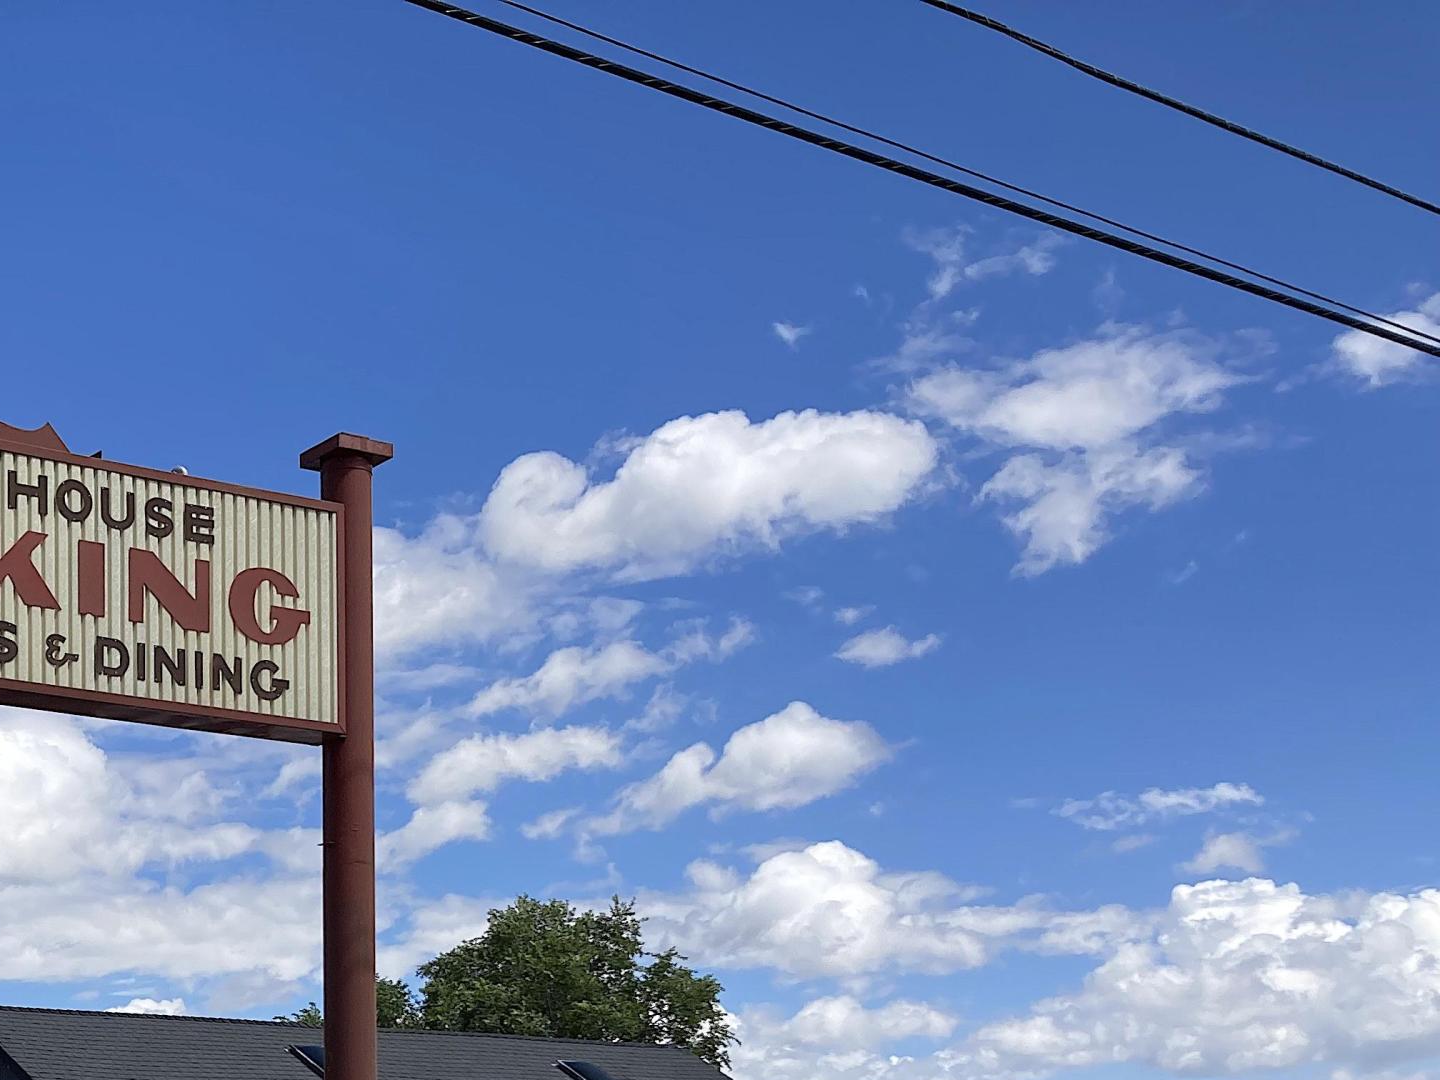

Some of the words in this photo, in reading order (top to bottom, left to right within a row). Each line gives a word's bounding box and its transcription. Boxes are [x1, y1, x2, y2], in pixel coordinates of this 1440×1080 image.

[7, 469, 215, 545] HOUSE
[45, 633, 79, 668] &
[94, 635, 291, 701] DINING
